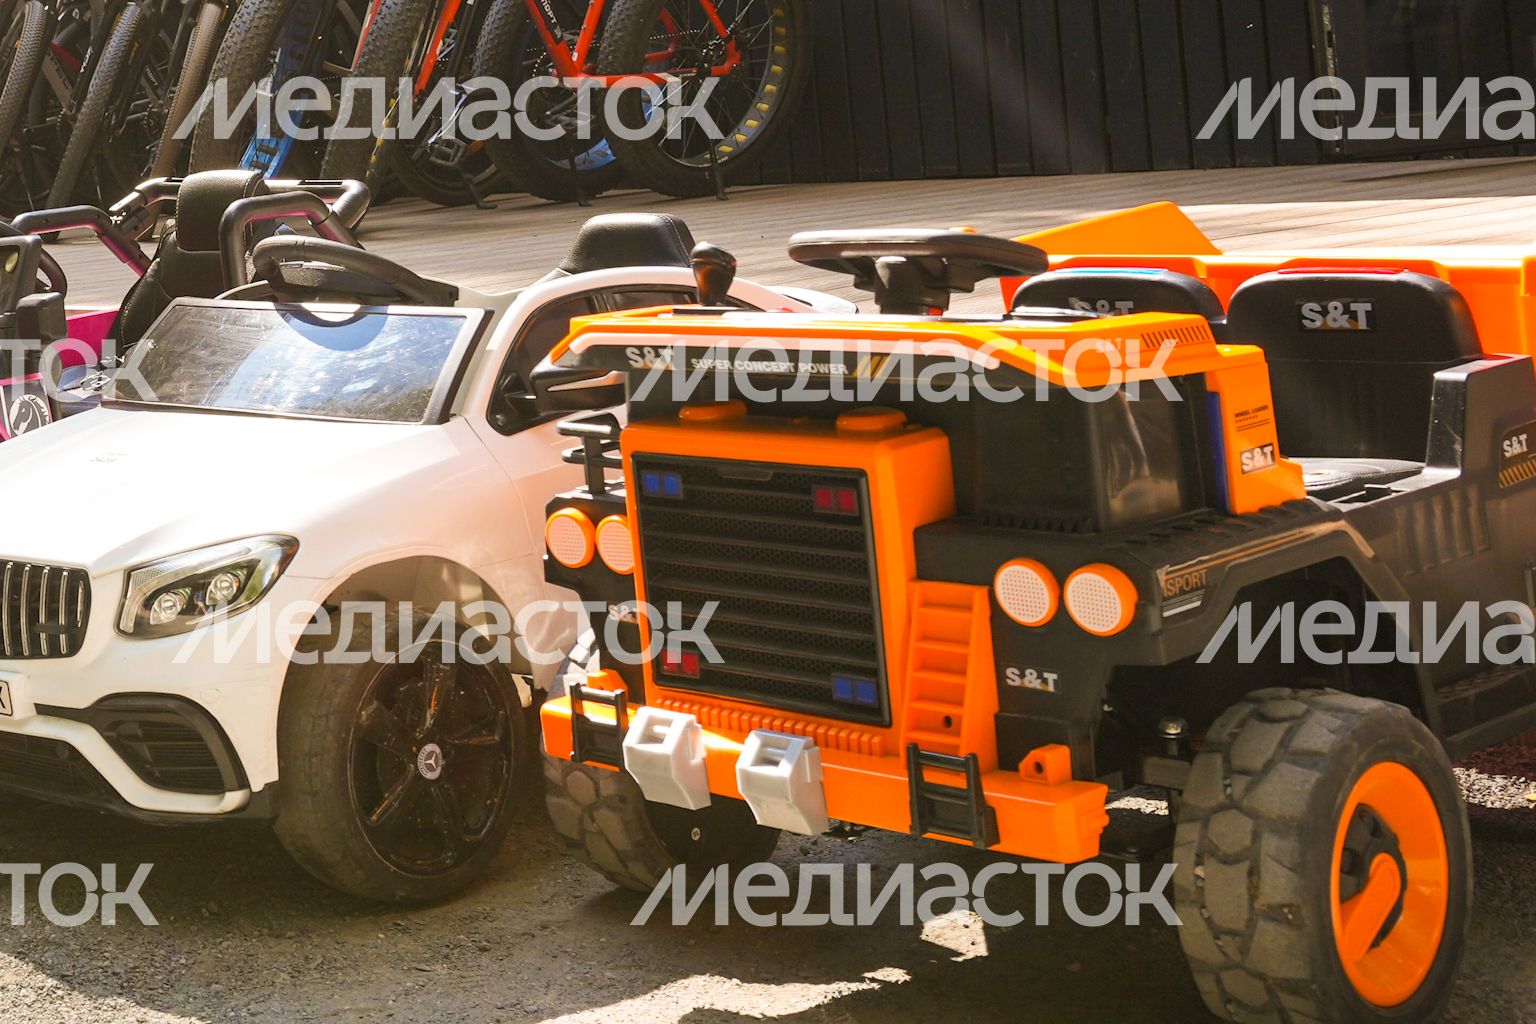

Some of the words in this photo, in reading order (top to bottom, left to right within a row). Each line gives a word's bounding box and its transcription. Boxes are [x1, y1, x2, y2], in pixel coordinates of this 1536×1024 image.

[1301, 300, 1372, 329] S&T
[624, 346, 676, 370] S&T
[690, 358, 733, 370] SUPER
[734, 360, 795, 373] CONCEPT
[798, 362, 848, 375] POWER
[1242, 445, 1274, 472] S&T
[1503, 434, 1528, 458] S&T
[1005, 667, 1058, 694] S&T
